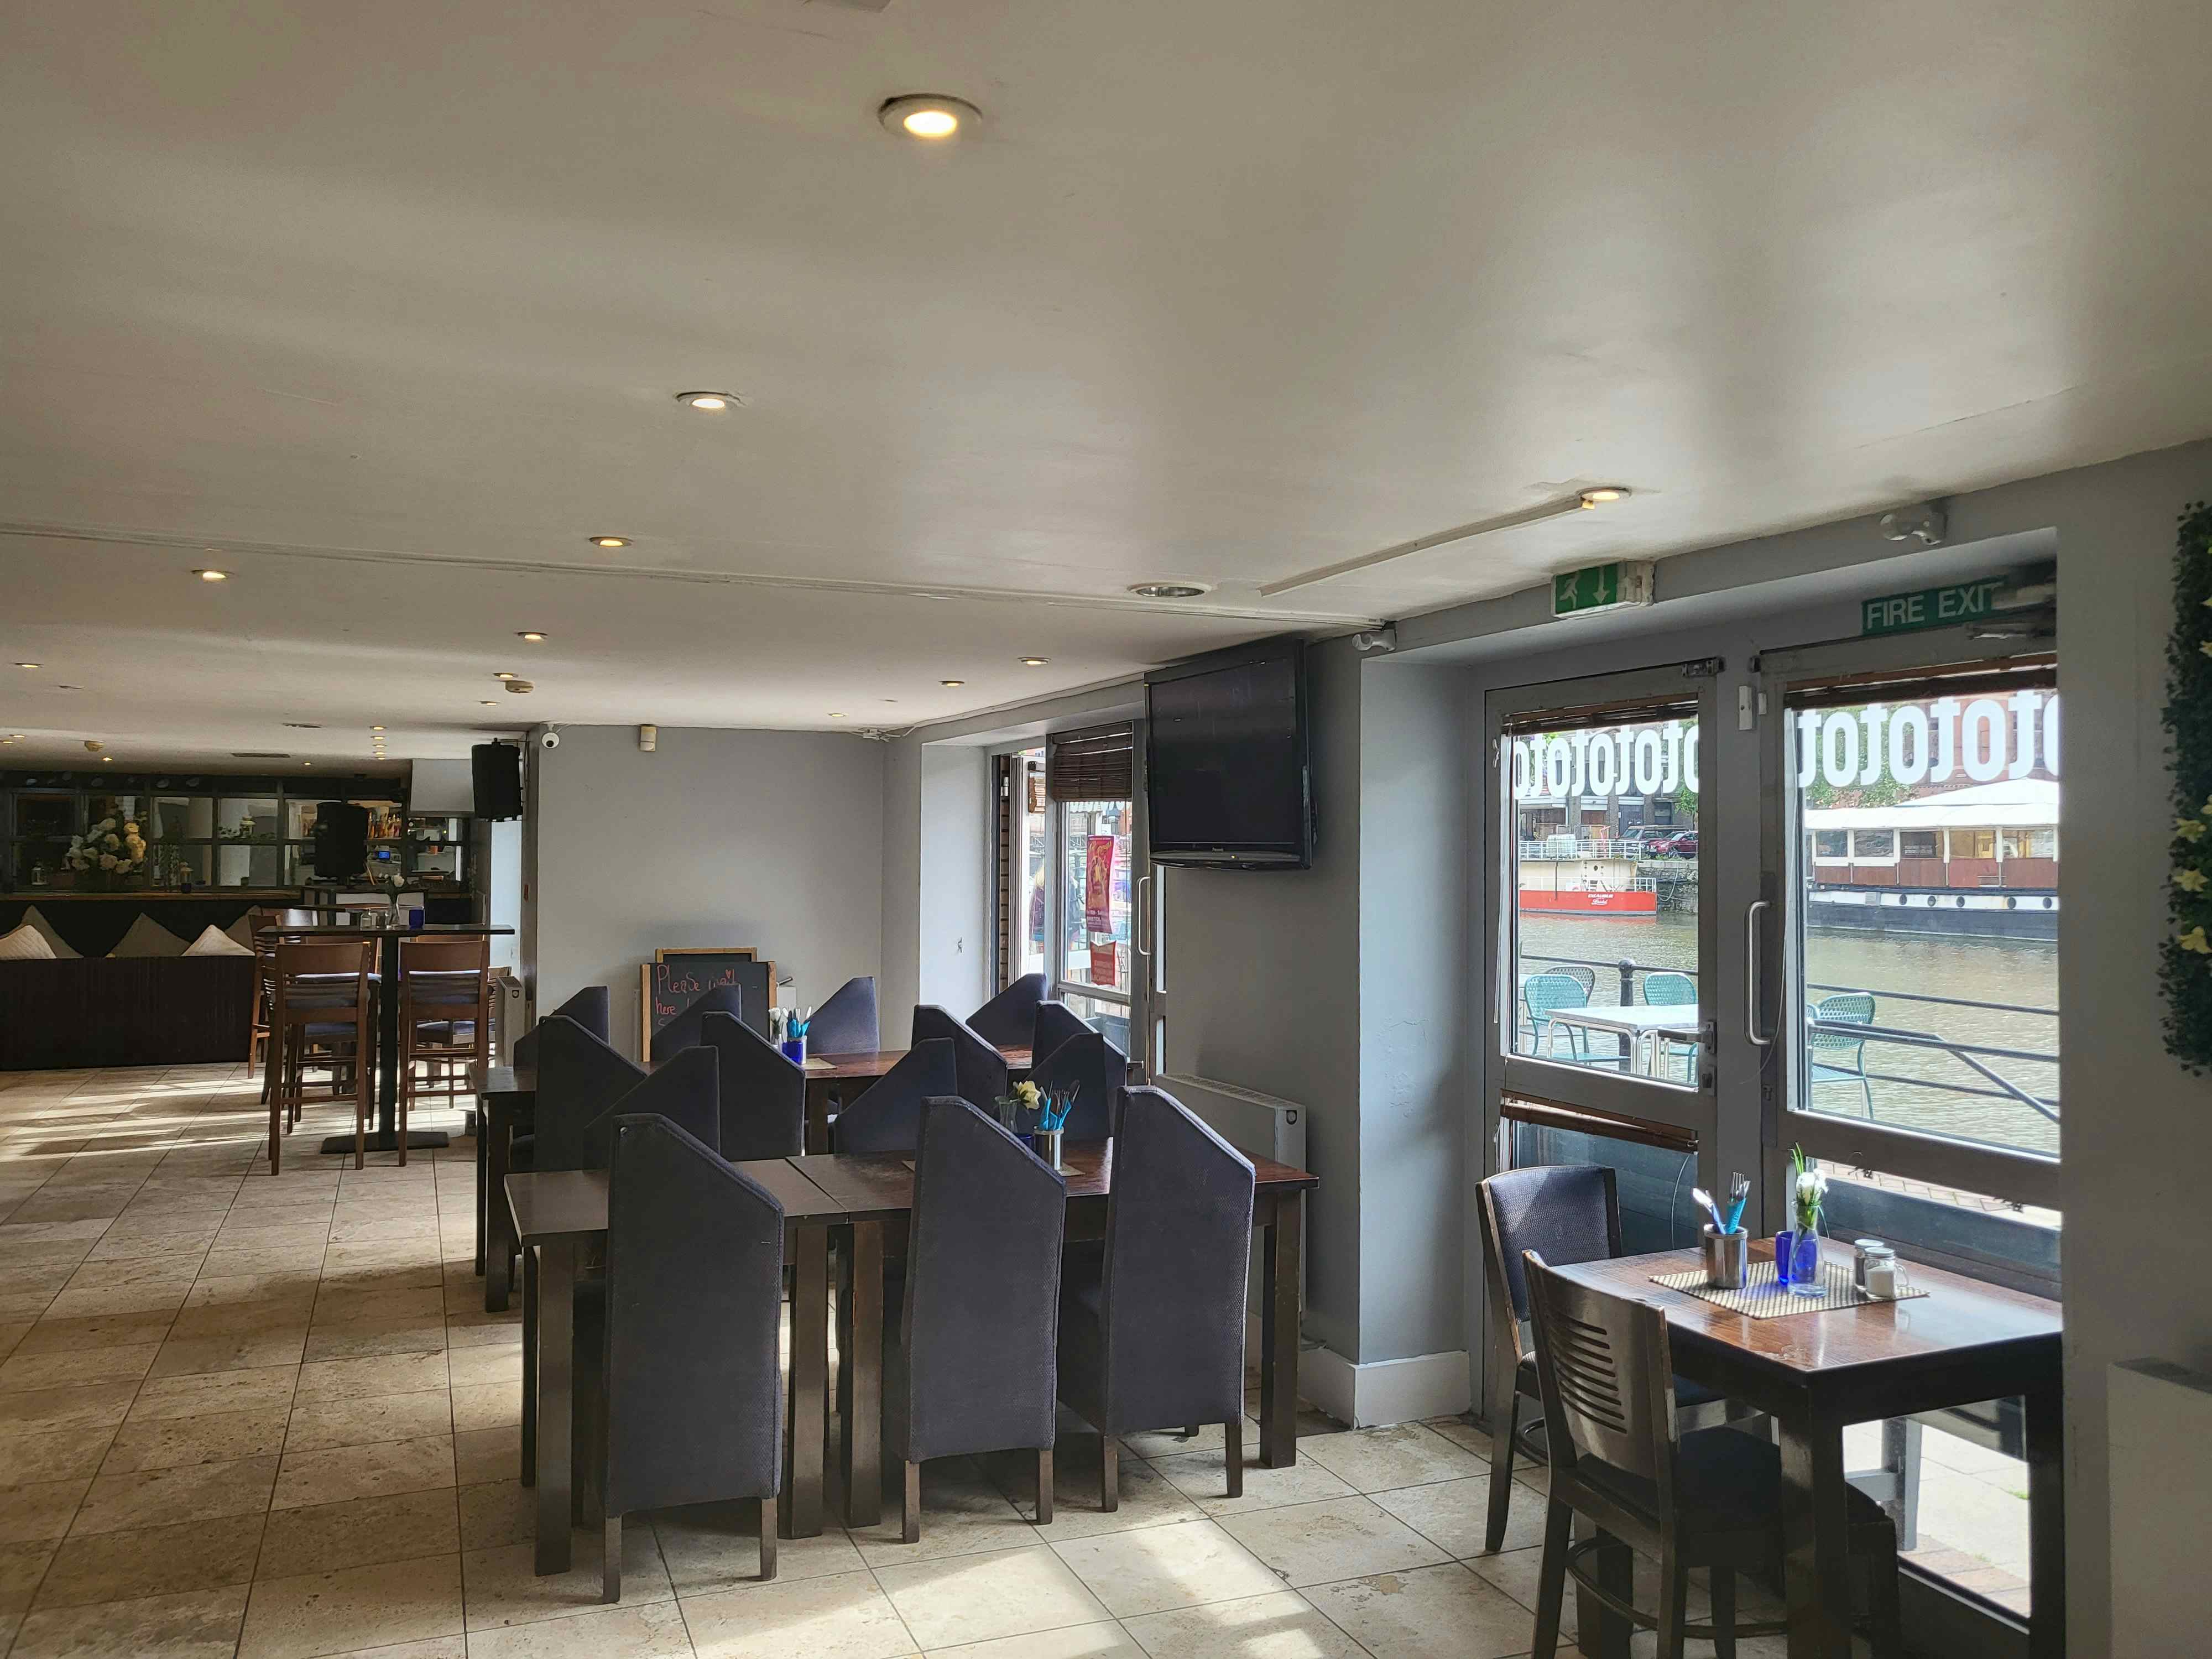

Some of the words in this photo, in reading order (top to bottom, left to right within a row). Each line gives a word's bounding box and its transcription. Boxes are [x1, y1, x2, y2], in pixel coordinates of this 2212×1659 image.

[1866, 595, 1925, 629] FIRE
[657, 964, 702, 994] Please
[655, 996, 677, 1015] here
